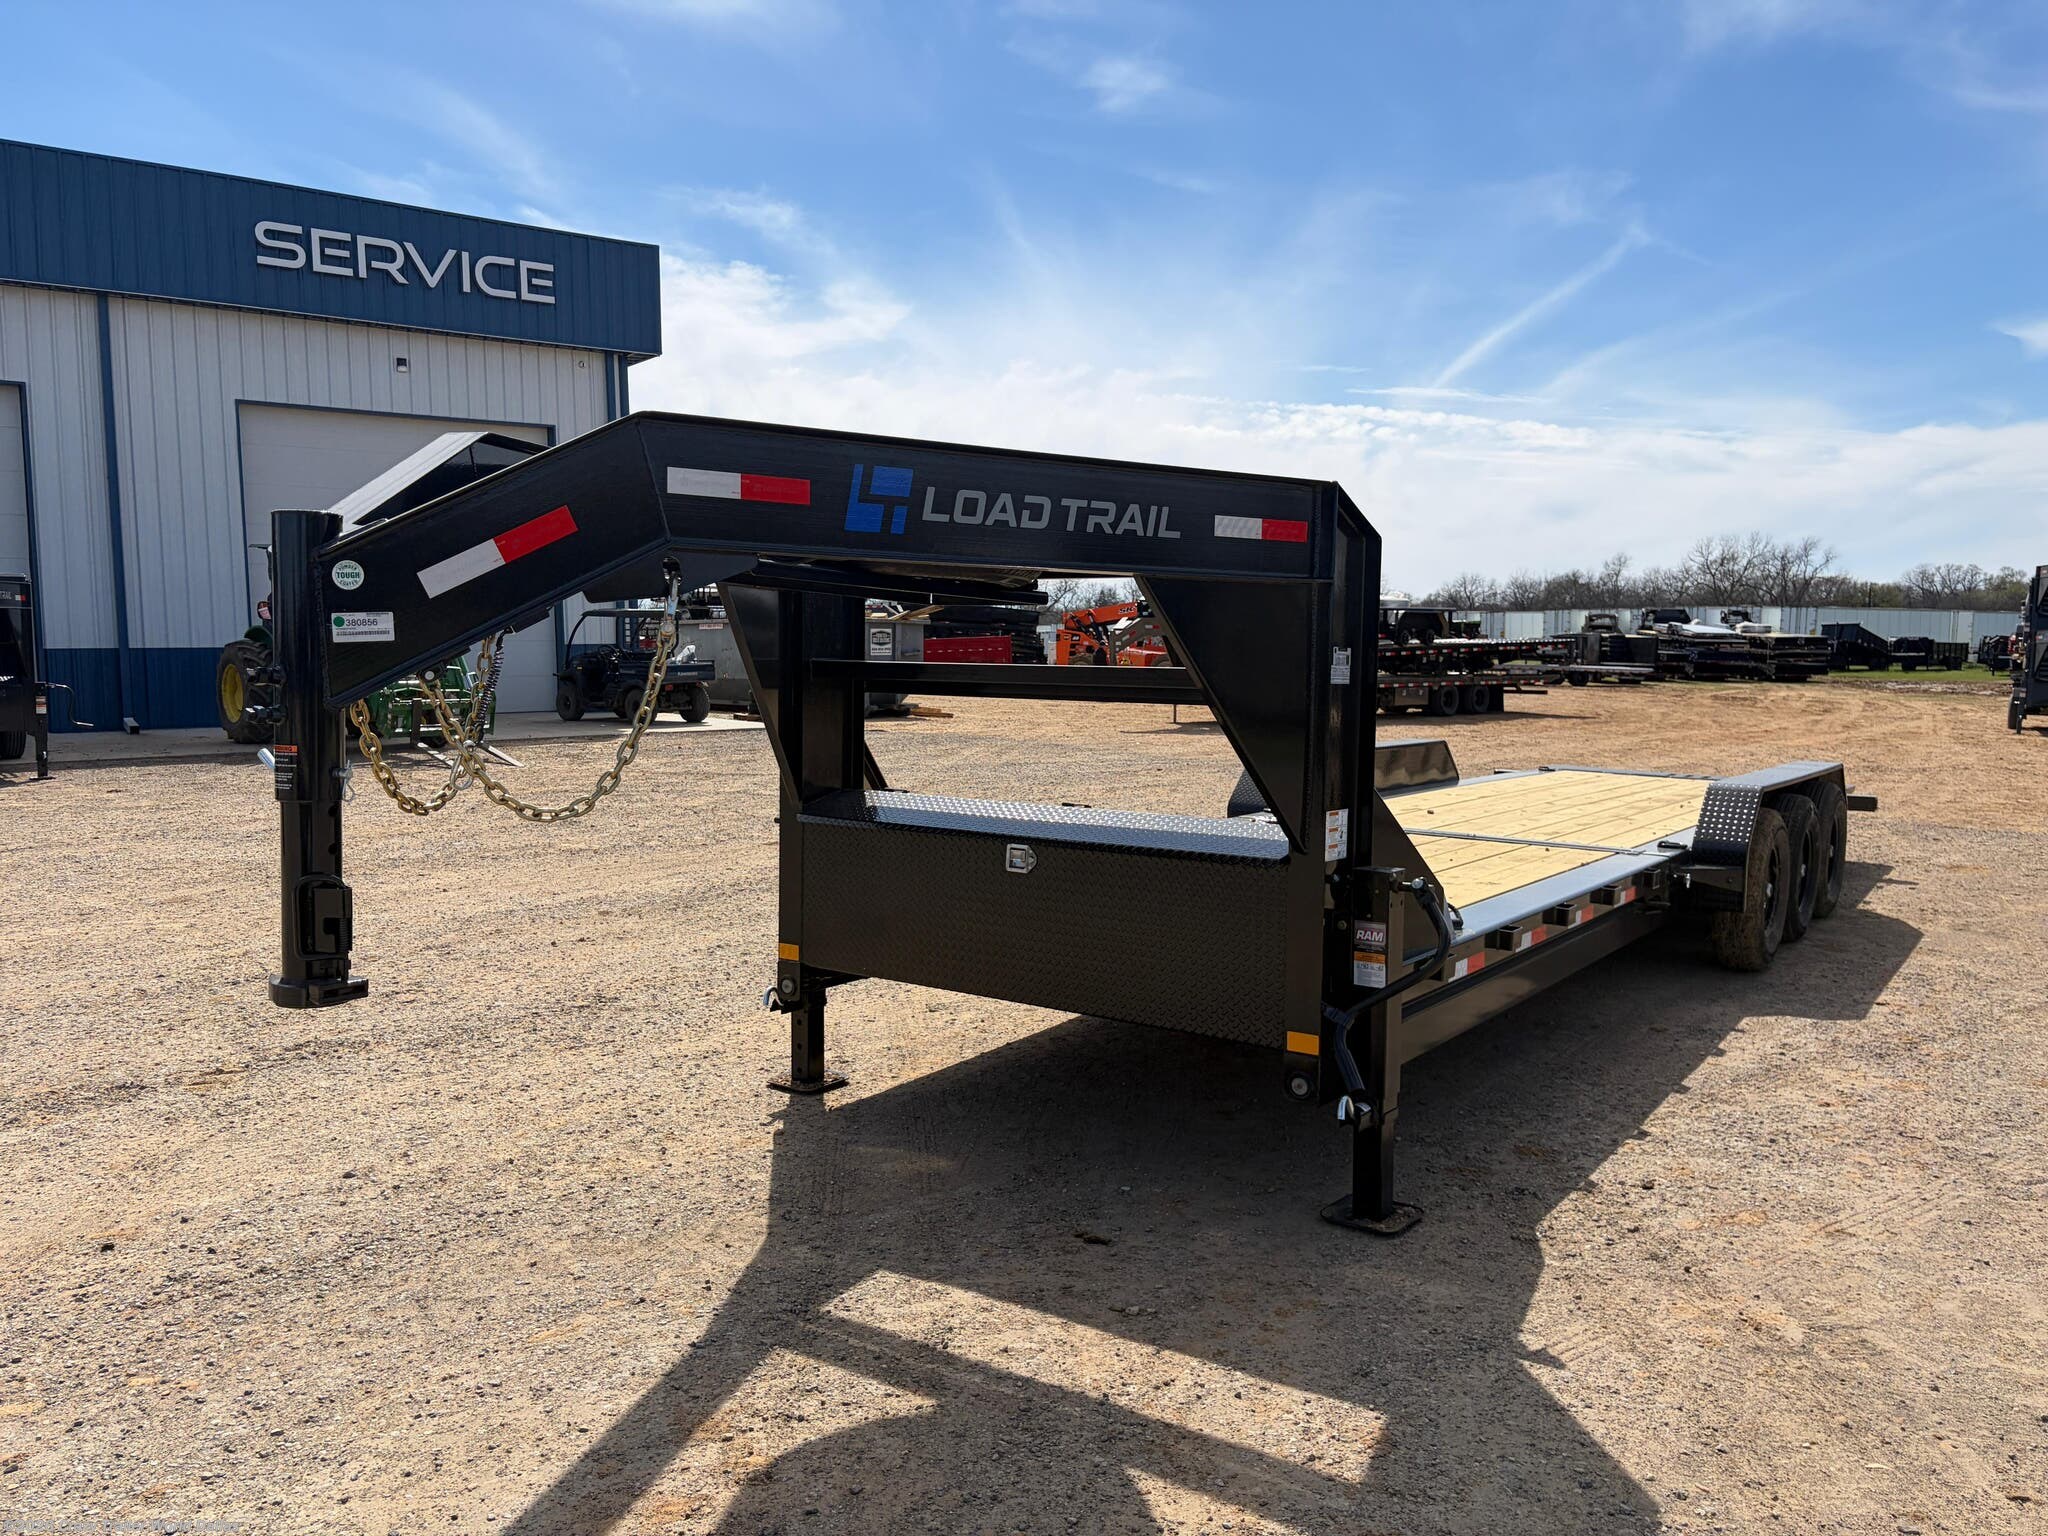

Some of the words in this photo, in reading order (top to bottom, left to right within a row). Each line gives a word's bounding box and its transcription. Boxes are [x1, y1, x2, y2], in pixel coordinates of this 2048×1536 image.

[255, 220, 556, 304] SERVICE
[922, 486, 1052, 530] LOAD
[1061, 497, 1182, 539] TRAIL
[336, 571, 360, 579] TOUGH
[345, 618, 378, 627] 380856
[1356, 929, 1384, 942] RAM
